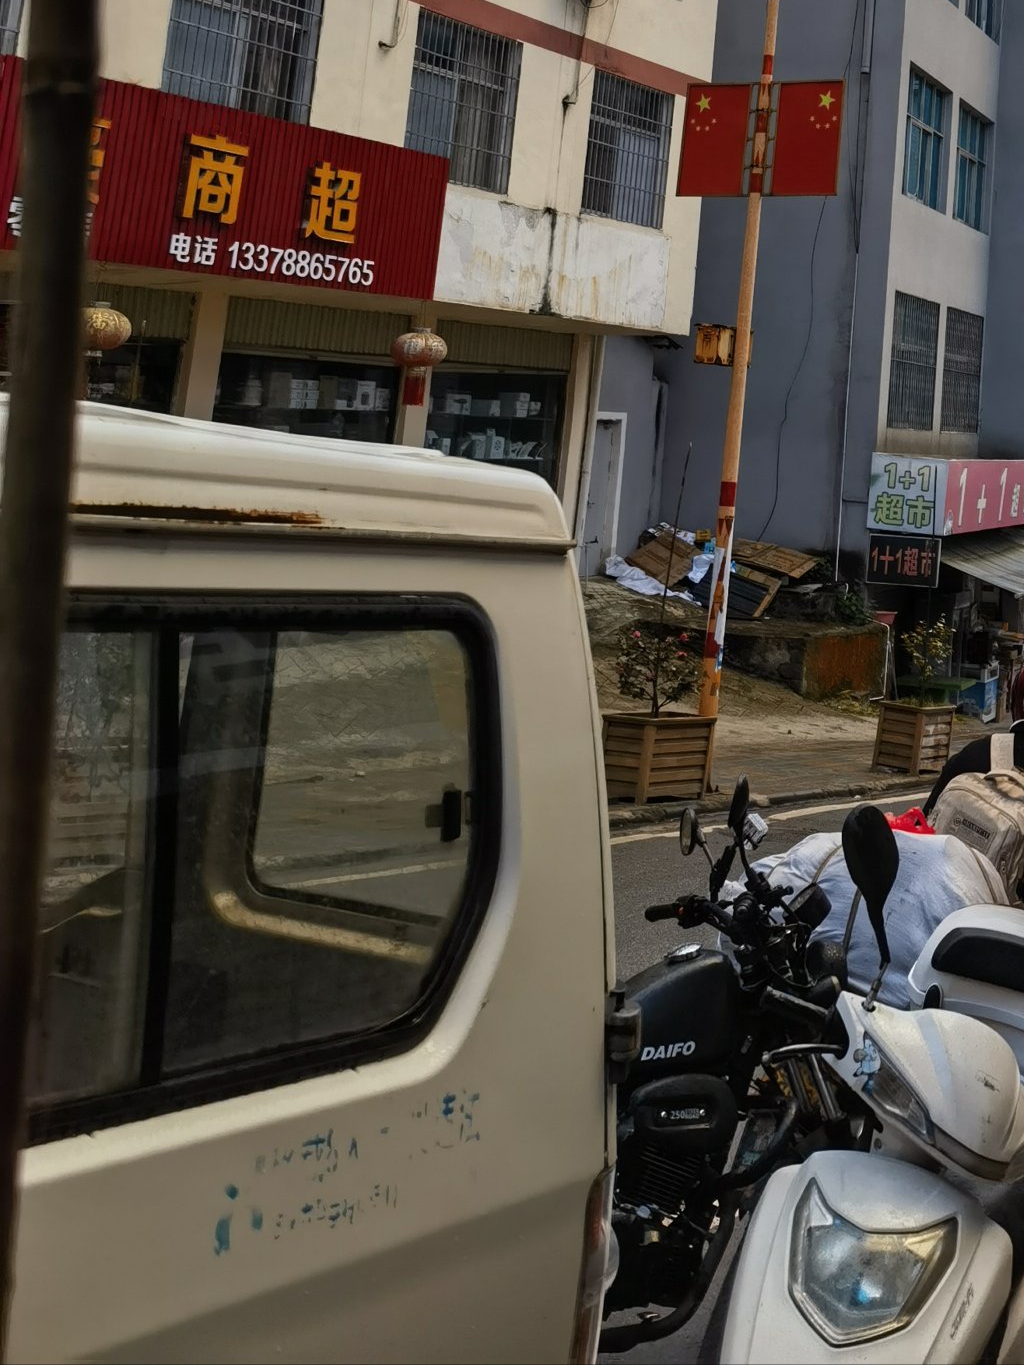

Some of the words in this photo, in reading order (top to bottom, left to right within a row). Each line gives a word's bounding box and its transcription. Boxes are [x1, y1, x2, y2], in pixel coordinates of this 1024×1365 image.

[89, 119, 362, 244] 商超
[169, 232, 218, 266] 电话
[228, 241, 375, 286] 13378865765
[884, 462, 932, 492] 1+1
[873, 491, 935, 529] 超市
[641, 1040, 696, 1061] DAIFO
